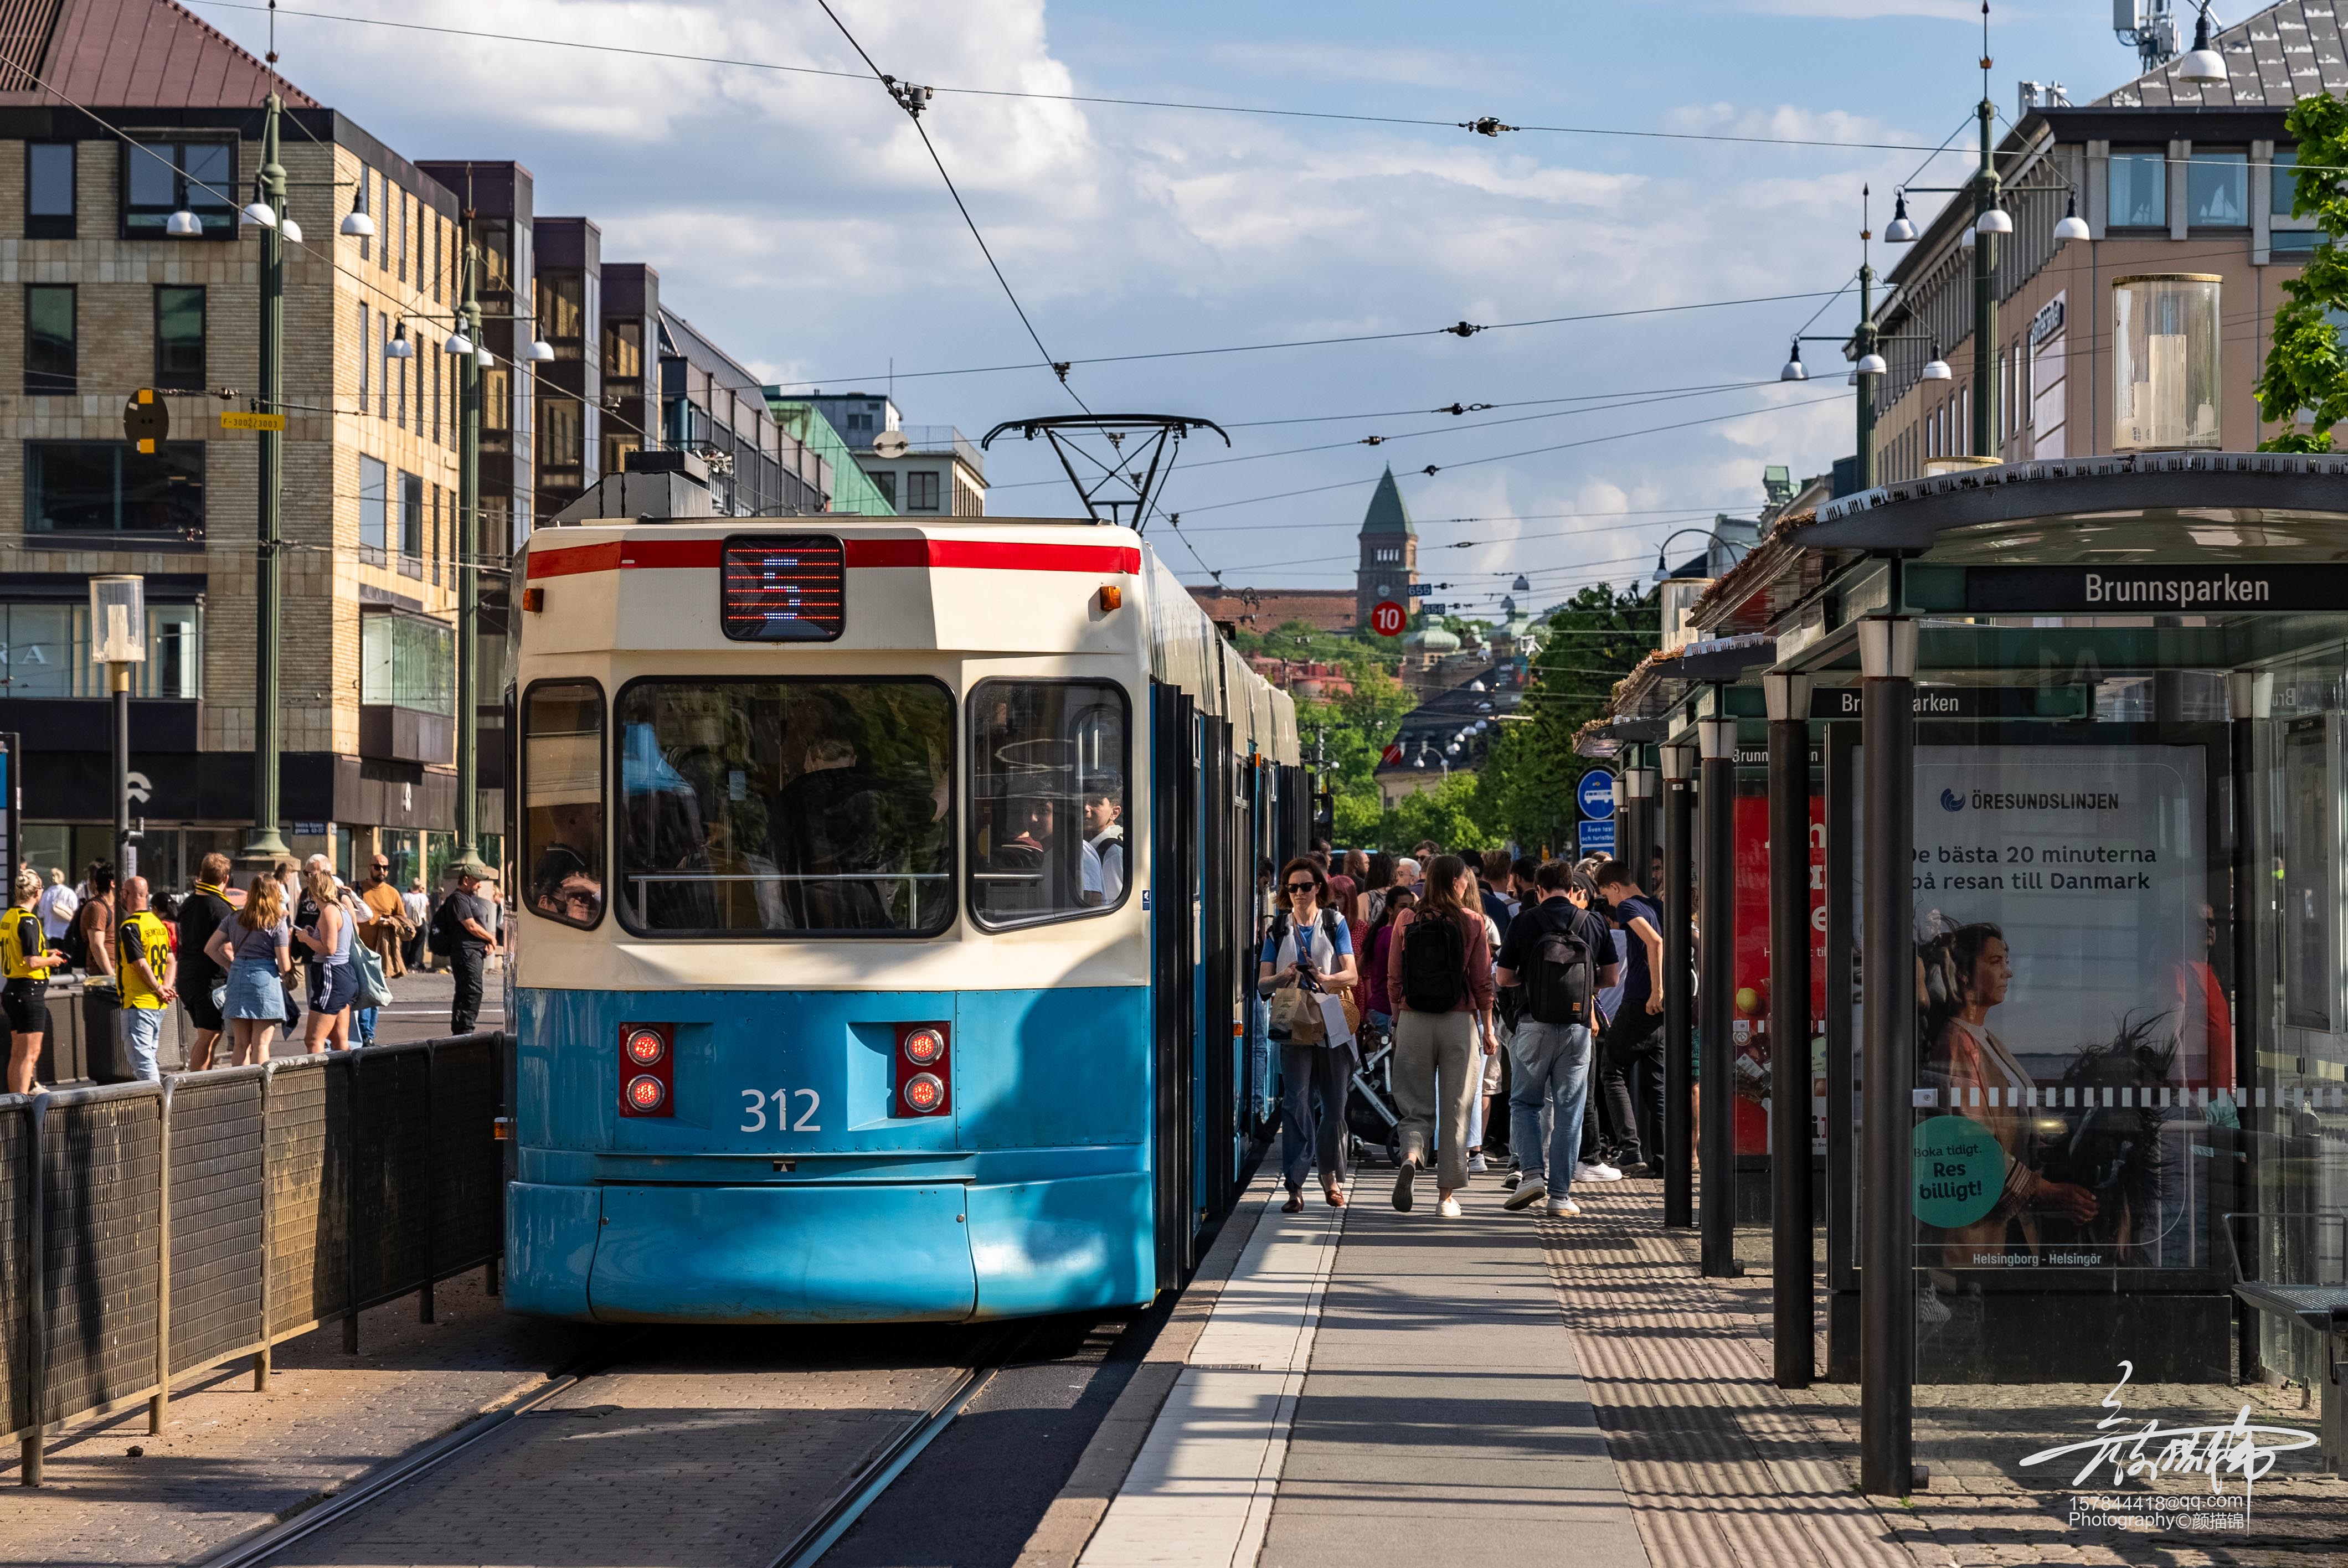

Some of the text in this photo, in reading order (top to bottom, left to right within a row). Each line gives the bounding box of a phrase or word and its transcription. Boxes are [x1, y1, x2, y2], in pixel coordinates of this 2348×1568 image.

[763, 559, 801, 620] 5
[1408, 585, 1430, 596] 655
[2086, 573, 2269, 607] Brunnsparken
[1377, 608, 1399, 630] 10
[1424, 605, 1445, 614] 656
[1972, 790, 2118, 809] ÖRESUNDSLINJEN
[1938, 846, 1998, 863] bästa
[2006, 846, 2034, 863] 20
[2042, 845, 2157, 863] minuterna
[1944, 876, 2004, 890] resan
[2011, 872, 2043, 889] till
[2051, 871, 2150, 890] Danmark
[151, 944, 167, 981] 88
[740, 1088, 821, 1133] 312
[1914, 1143, 1982, 1158] Boka tidigt.
[1933, 1162, 1966, 1178] Res
[1919, 1180, 1982, 1202] billigt!
[1973, 1253, 2038, 1266] Helsingborg
[2050, 1253, 2102, 1266] Helsingör
